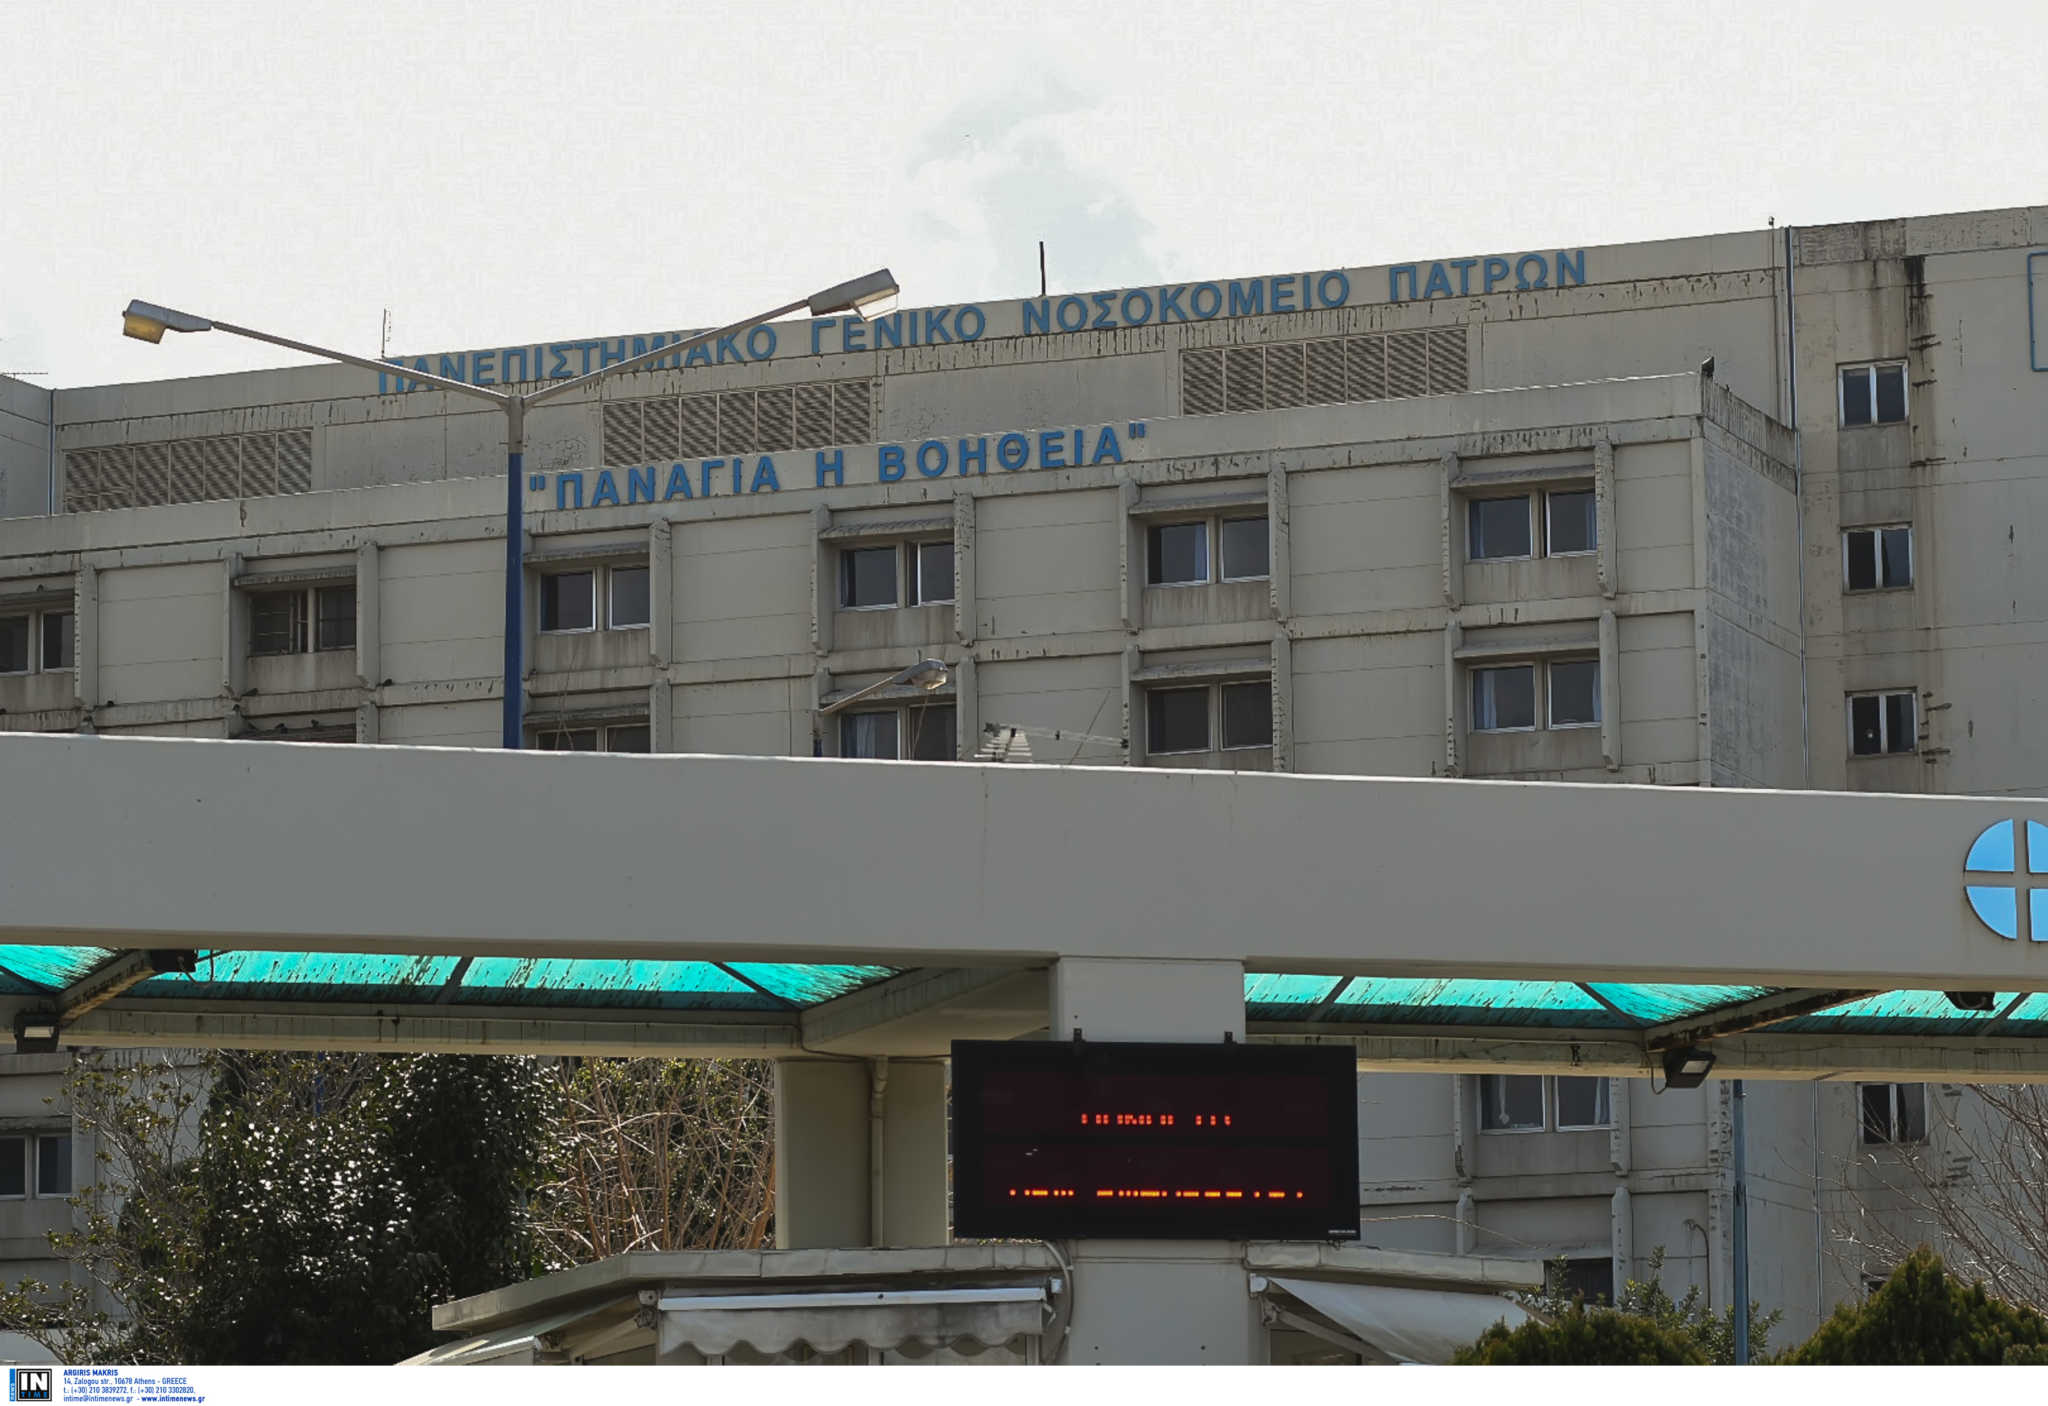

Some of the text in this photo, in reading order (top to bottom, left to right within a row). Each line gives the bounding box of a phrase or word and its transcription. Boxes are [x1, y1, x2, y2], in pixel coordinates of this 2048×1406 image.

[811, 305, 986, 355] ΓΕΝΙΚΟ
[1022, 270, 1350, 335] ΝΟΣΟΚΟΜΕΙΟ
[1389, 250, 1586, 300] ΠΑΤΡΩΝ
[816, 449, 844, 488] Η
